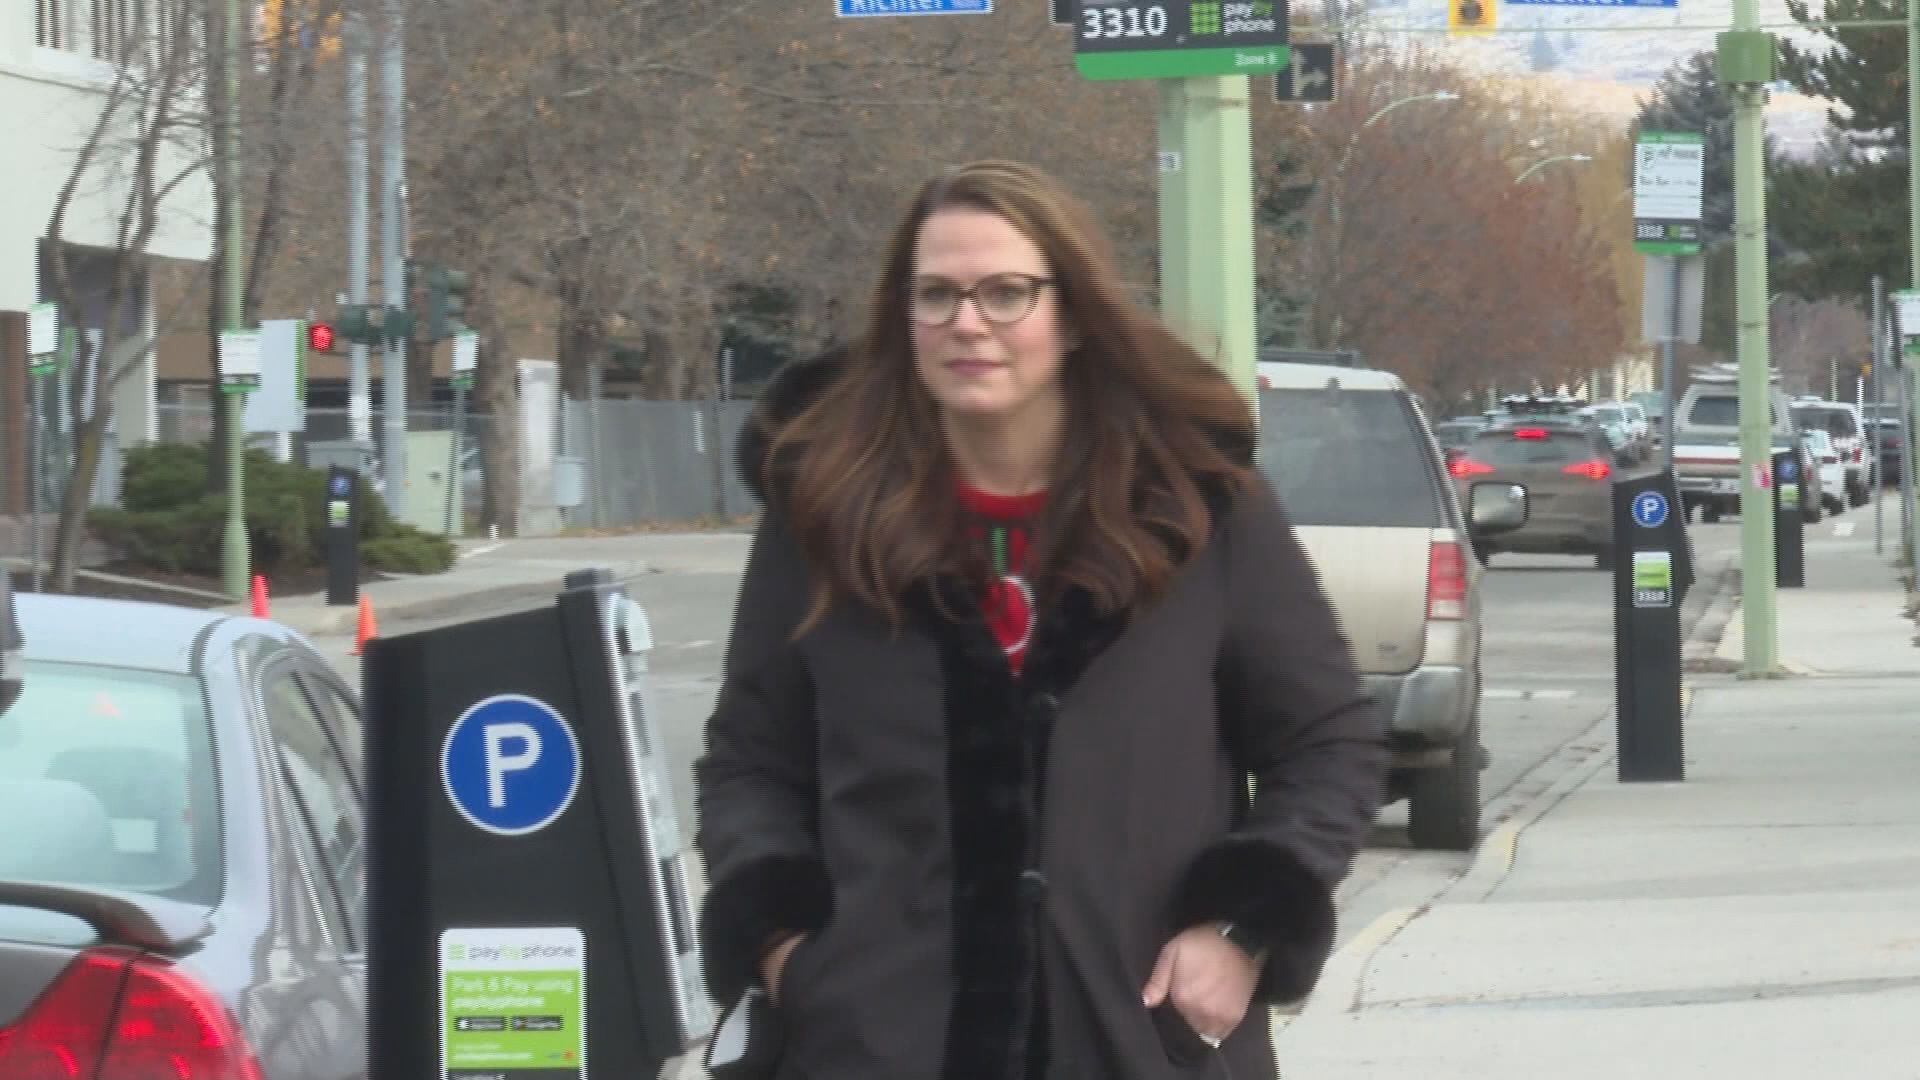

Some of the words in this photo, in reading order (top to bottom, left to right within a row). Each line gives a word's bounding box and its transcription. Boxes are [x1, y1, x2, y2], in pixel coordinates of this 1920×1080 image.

[1082, 6, 1168, 39] 3310
[1223, 18, 1276, 36] phone
[1235, 53, 1265, 66] Zone
[1642, 498, 1659, 521] P
[482, 722, 543, 808] P
[469, 943, 577, 961] paybyphone
